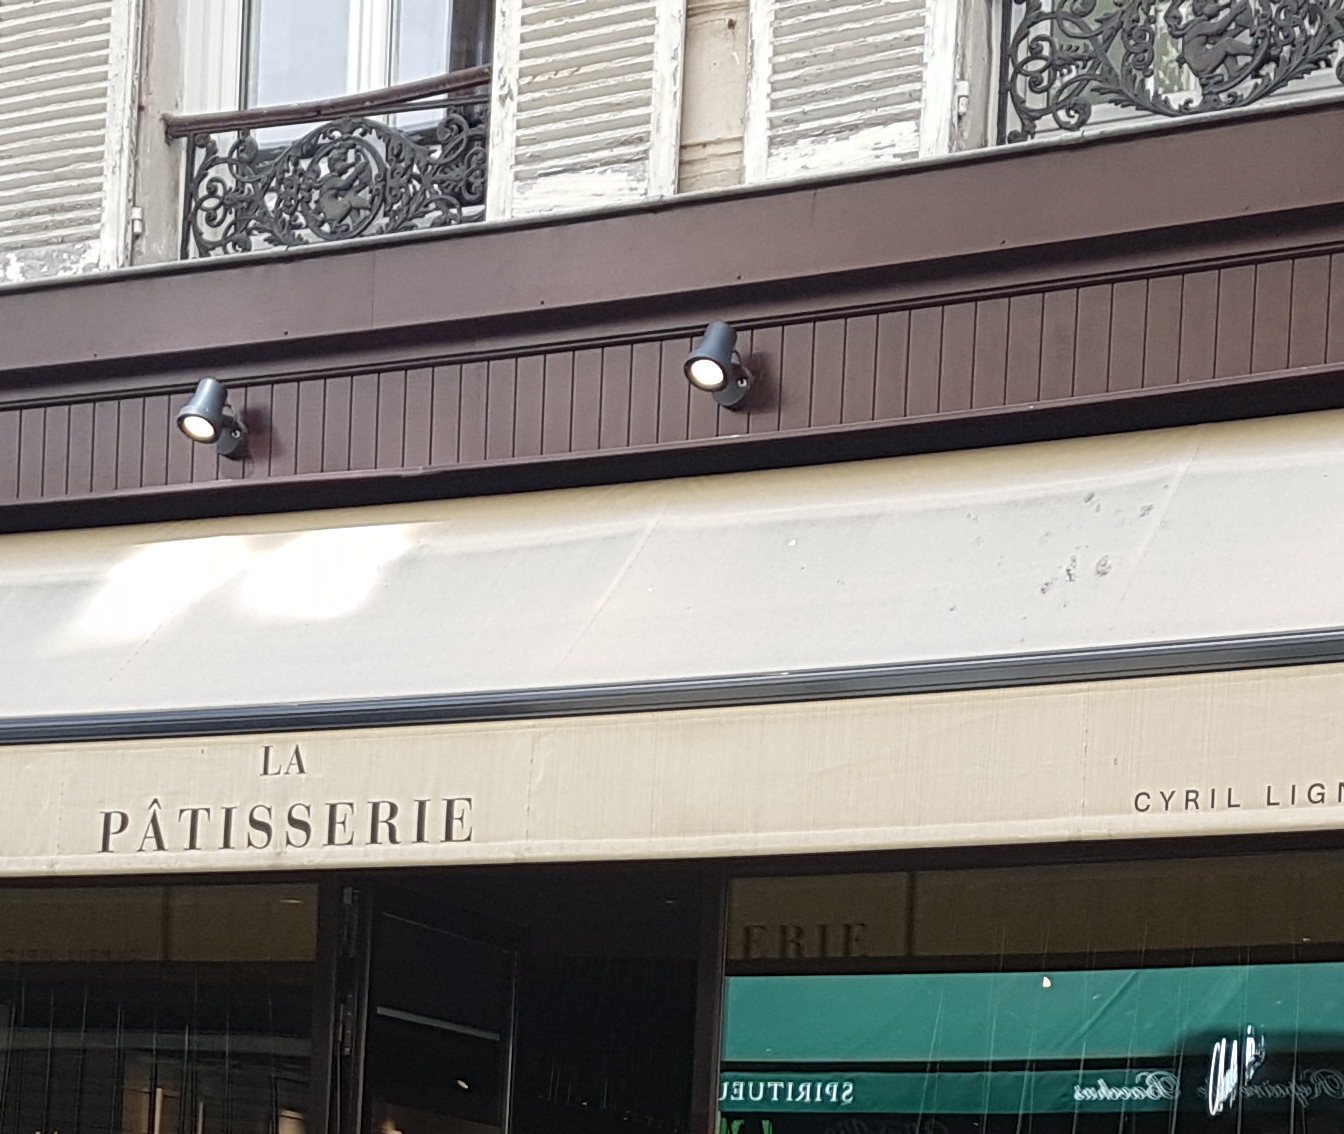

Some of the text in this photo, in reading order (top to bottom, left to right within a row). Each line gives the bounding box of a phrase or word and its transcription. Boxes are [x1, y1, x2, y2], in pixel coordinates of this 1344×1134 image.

[259, 743, 307, 776] LA
[1134, 785, 1241, 814] CYRIL
[97, 797, 474, 854] PÂTISSERIE
